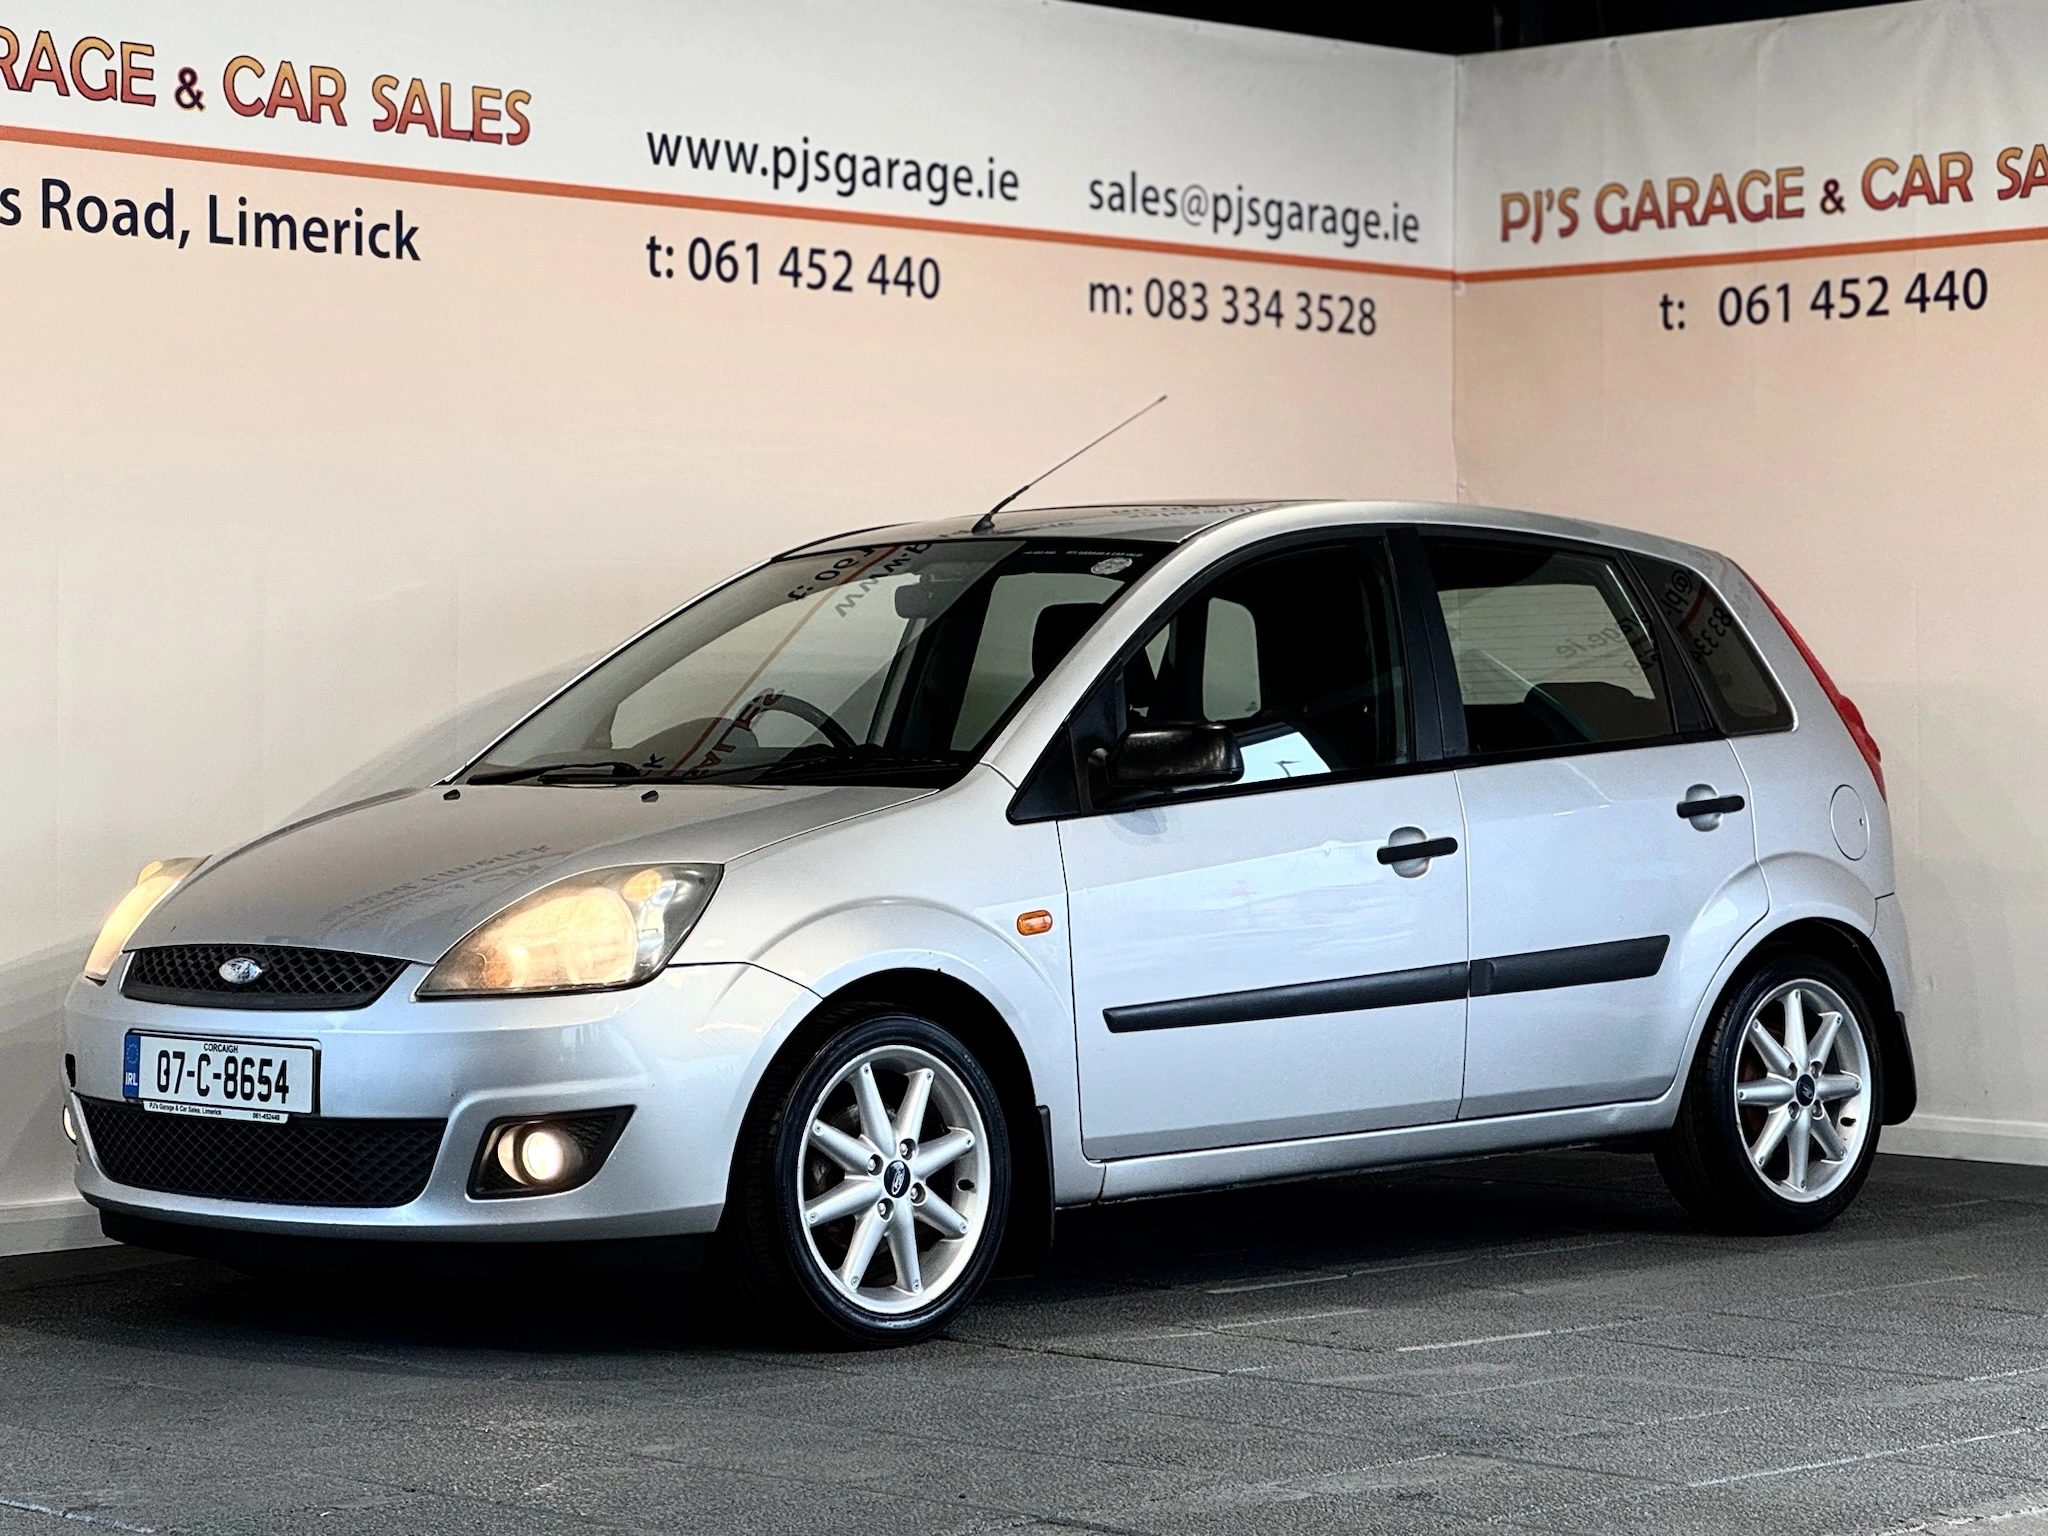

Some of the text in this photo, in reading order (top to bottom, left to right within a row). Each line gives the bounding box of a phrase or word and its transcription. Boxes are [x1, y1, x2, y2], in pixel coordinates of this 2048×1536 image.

[0, 26, 532, 146] RAGE & CAR SALES
[647, 132, 1020, 206] www.pjsgarage.ie
[1501, 187, 1580, 244] PJ'S
[1594, 167, 1805, 235] GARAGE
[1820, 178, 1846, 215] &
[1861, 151, 1974, 211] CAR
[42, 178, 191, 249] Road,
[209, 194, 422, 261] Limerick
[1088, 172, 1420, 248] sales@pjsgarage.ie
[646, 236, 941, 299] t: 061 452 440
[1659, 267, 1988, 330] t: 061 452 440
[1088, 277, 1377, 336] m: 083 334 3528
[125, 1072, 138, 1086] IRL
[157, 1050, 290, 1104] 07-C-8654
[203, 1043, 239, 1053] CORCAIGH
